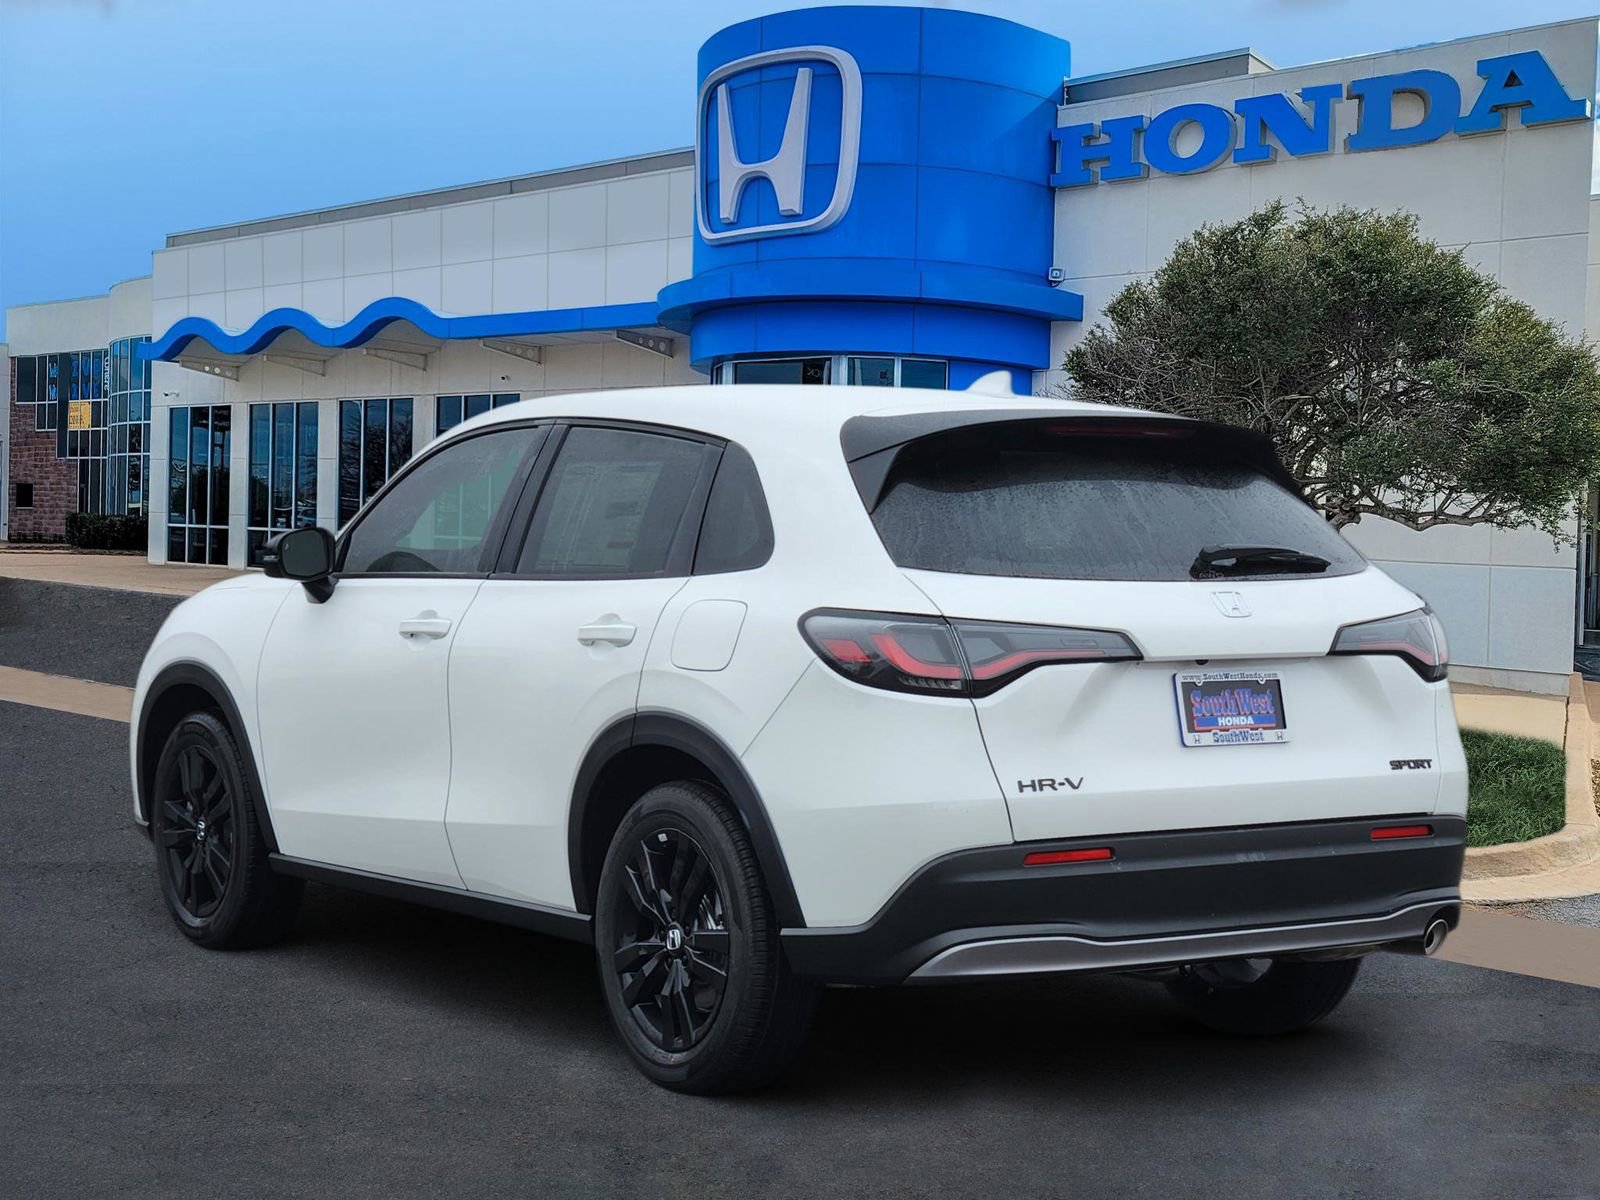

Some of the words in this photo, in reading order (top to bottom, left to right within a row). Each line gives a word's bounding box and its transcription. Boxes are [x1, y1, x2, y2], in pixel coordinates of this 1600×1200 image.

[1050, 50, 1591, 188] HONDA
[1218, 717, 1254, 726] HONDA
[1213, 730, 1264, 743] SouthWest
[1389, 758, 1433, 770] SPORT
[1017, 776, 1084, 793] HR-V
